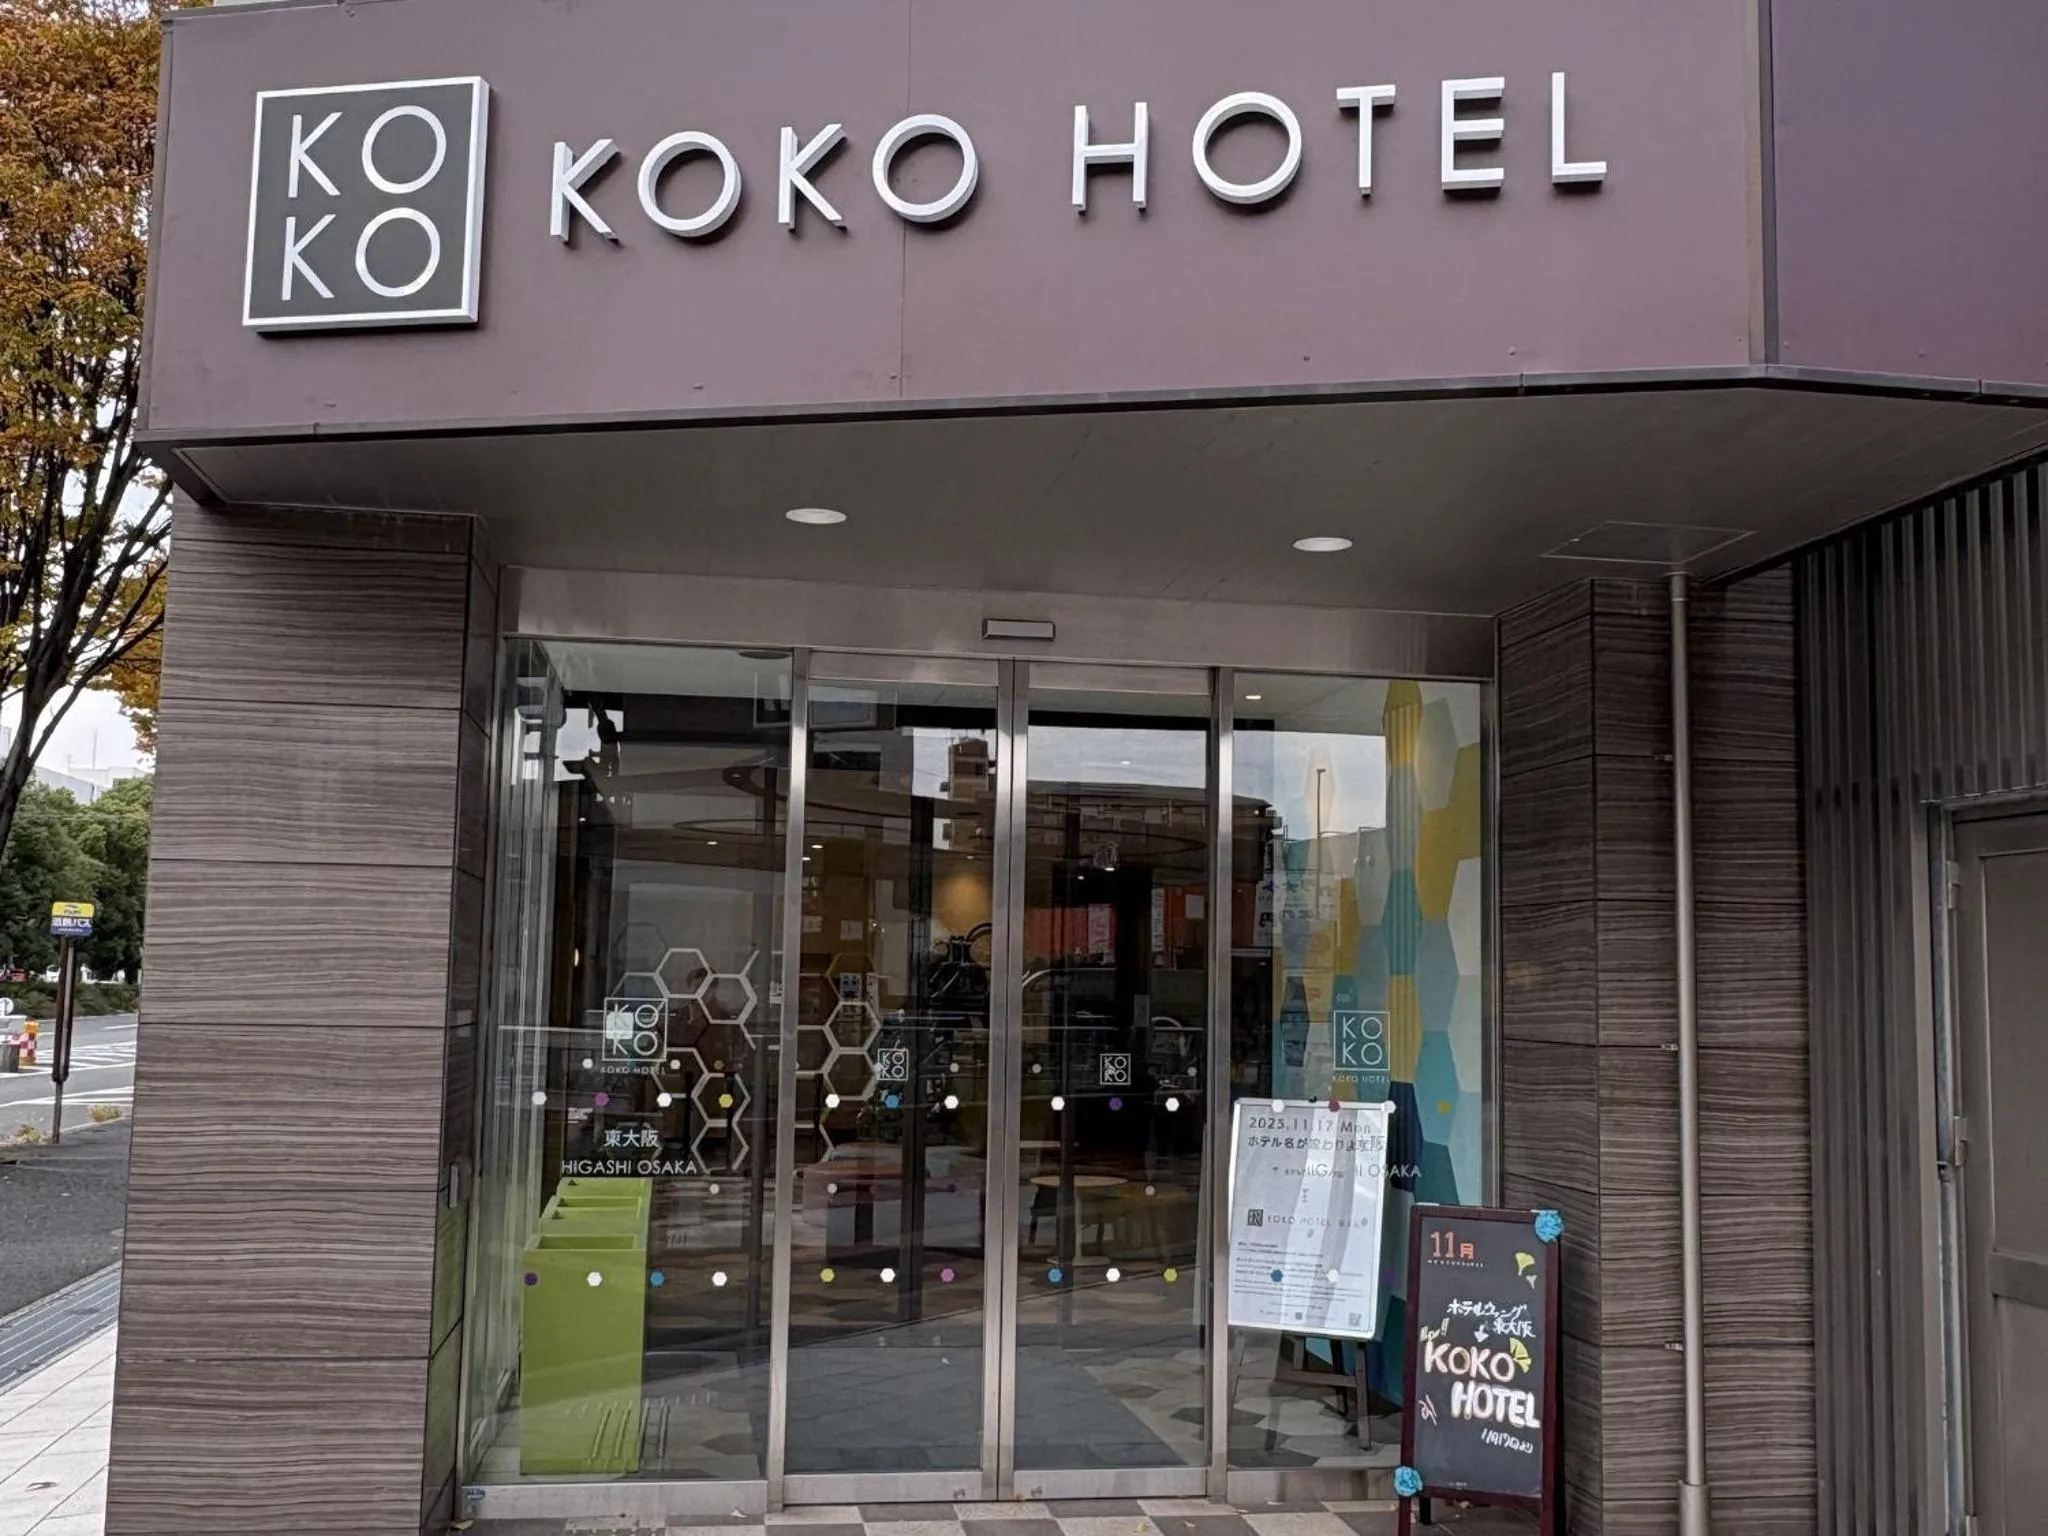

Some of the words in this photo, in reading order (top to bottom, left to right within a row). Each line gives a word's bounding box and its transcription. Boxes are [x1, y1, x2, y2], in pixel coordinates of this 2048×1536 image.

[550, 114, 979, 243] KOKO
[1072, 71, 1608, 211] HOTEL
[604, 1129, 660, 1148] 東大阪
[561, 1159, 632, 1174] HIGASHI
[637, 1159, 698, 1175] OSAKA
[1424, 1340, 1515, 1383] KOKO
[1451, 1379, 1541, 1429] HOTEL
